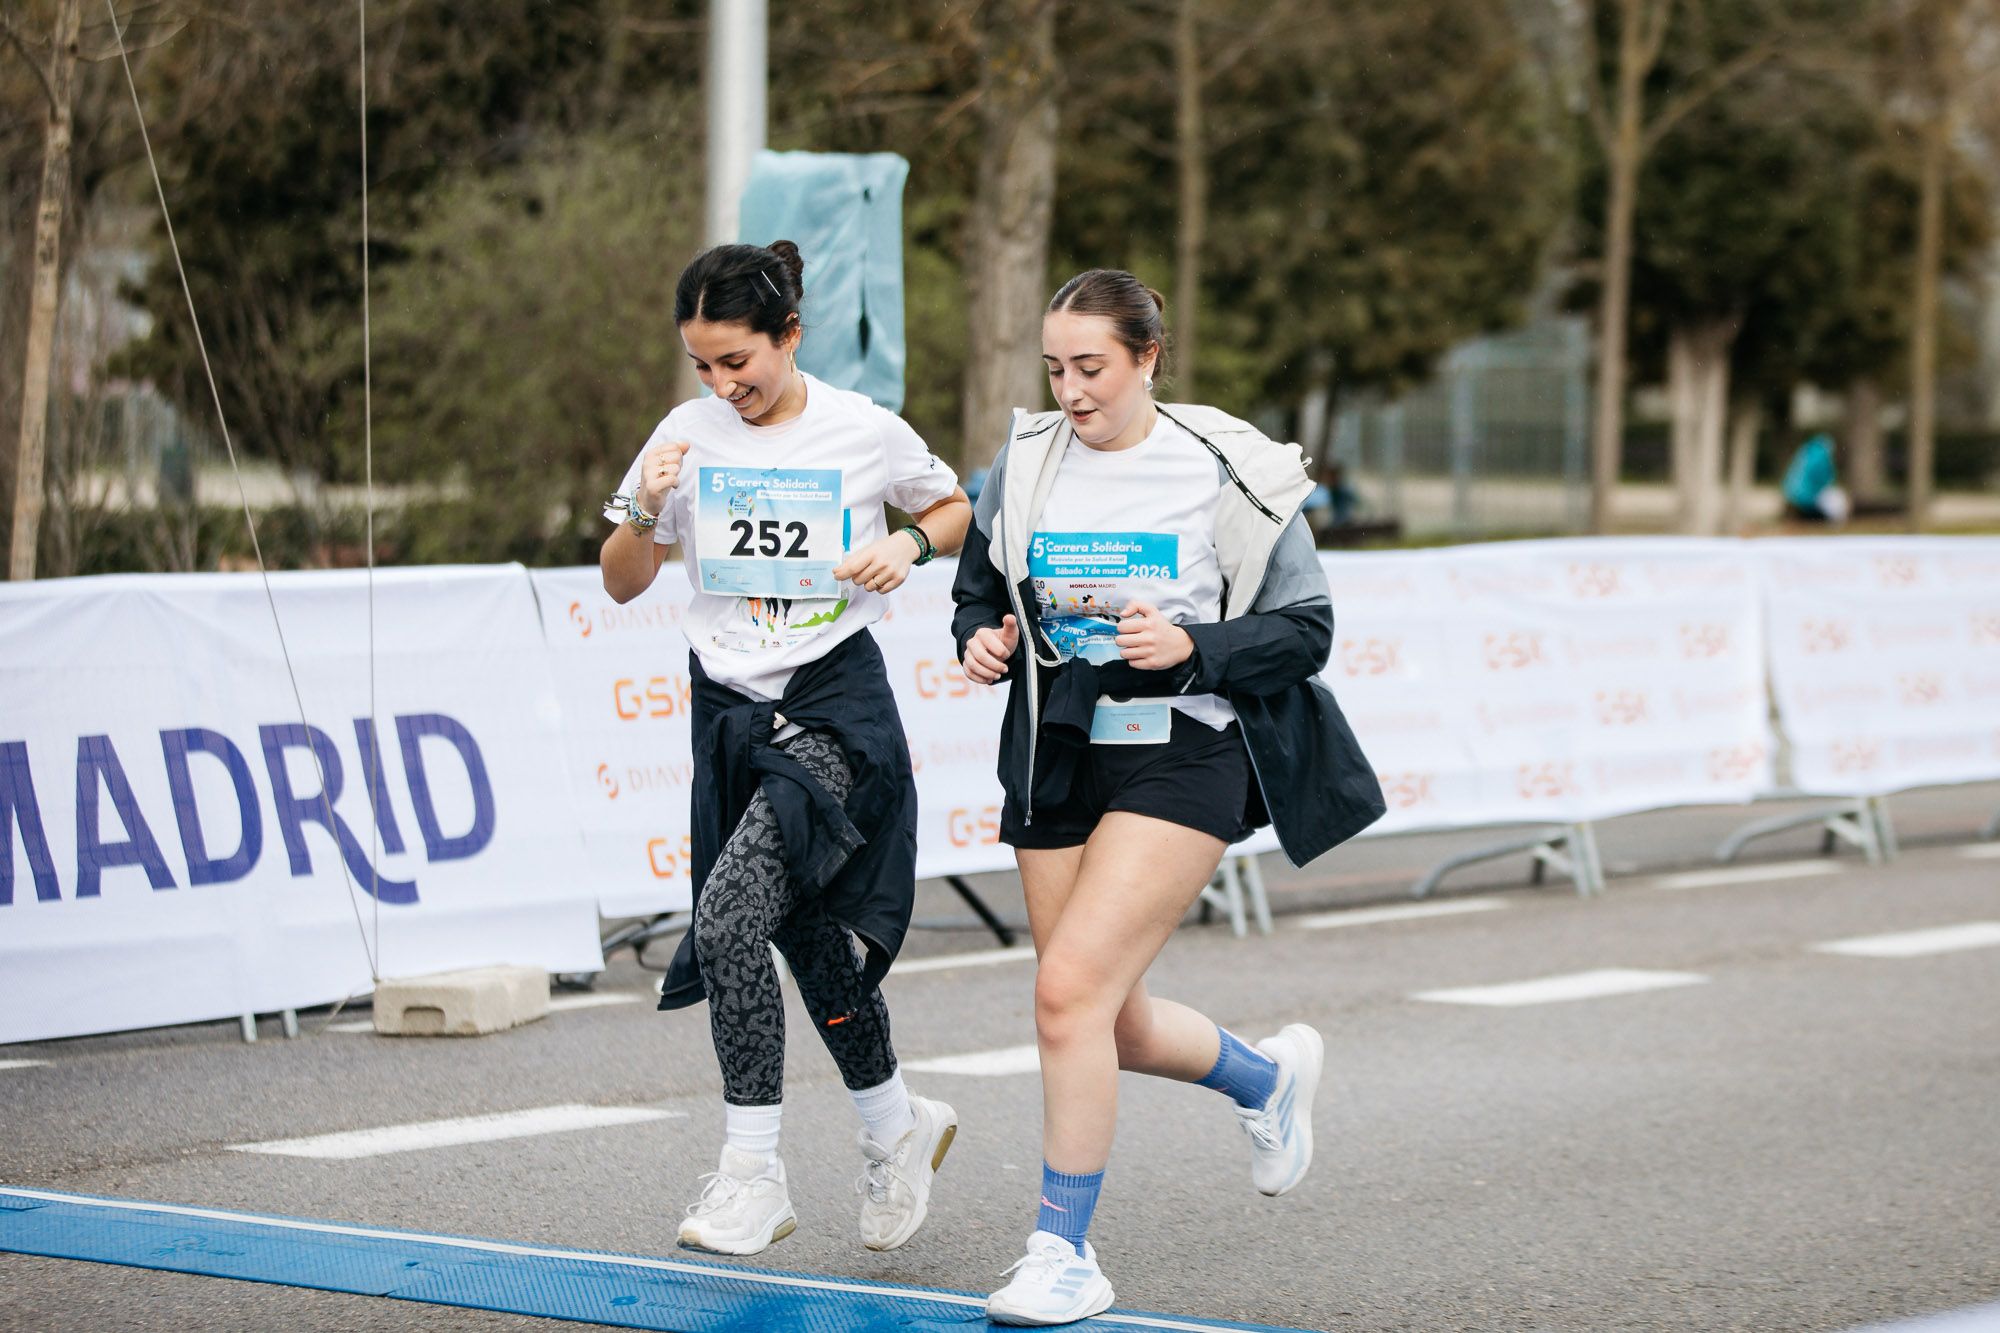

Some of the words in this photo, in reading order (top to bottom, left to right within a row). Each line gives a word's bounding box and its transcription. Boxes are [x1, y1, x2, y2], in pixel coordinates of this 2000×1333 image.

[728, 477, 770, 489] Carrera
[773, 478, 818, 489] Solidaria
[730, 519, 809, 558] 252
[1046, 541, 1088, 552] Carrera
[1092, 541, 1142, 552] Solidaria
[1055, 567, 1083, 575] Sábado
[1084, 567, 1090, 575] 7
[1091, 567, 1101, 575] de
[1128, 565, 1171, 579] 2026
[799, 578, 812, 587] CSL
[1060, 624, 1087, 637] Carrera
[1126, 724, 1141, 732] CSL
